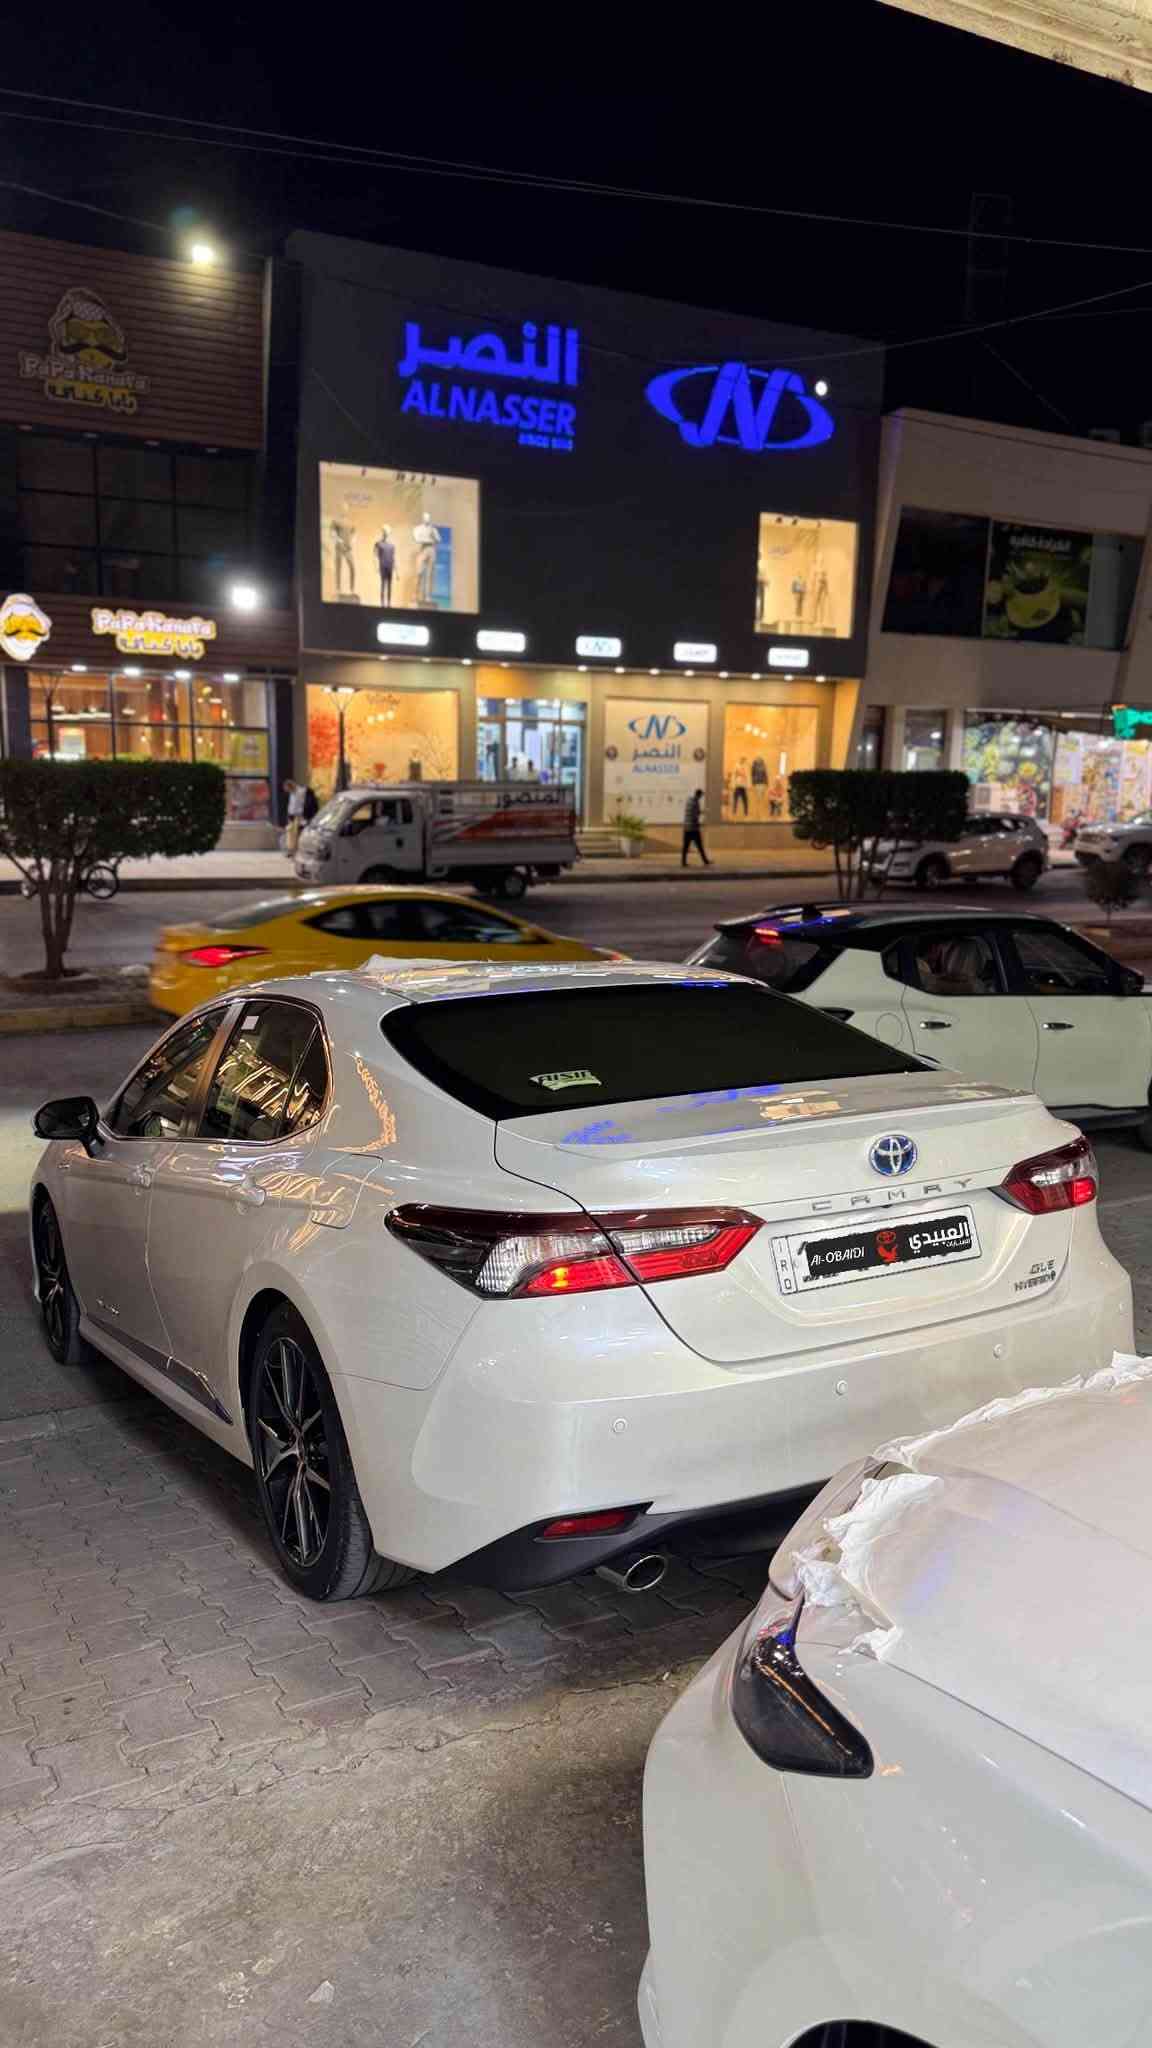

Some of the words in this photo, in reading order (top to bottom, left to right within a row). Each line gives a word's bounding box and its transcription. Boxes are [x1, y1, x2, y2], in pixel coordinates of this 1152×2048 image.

[397, 319, 579, 386] النصر
[401, 378, 576, 436] ALNASSER
[811, 1178, 972, 1212] CAMRY
[1030, 1259, 1056, 1274] GLE
